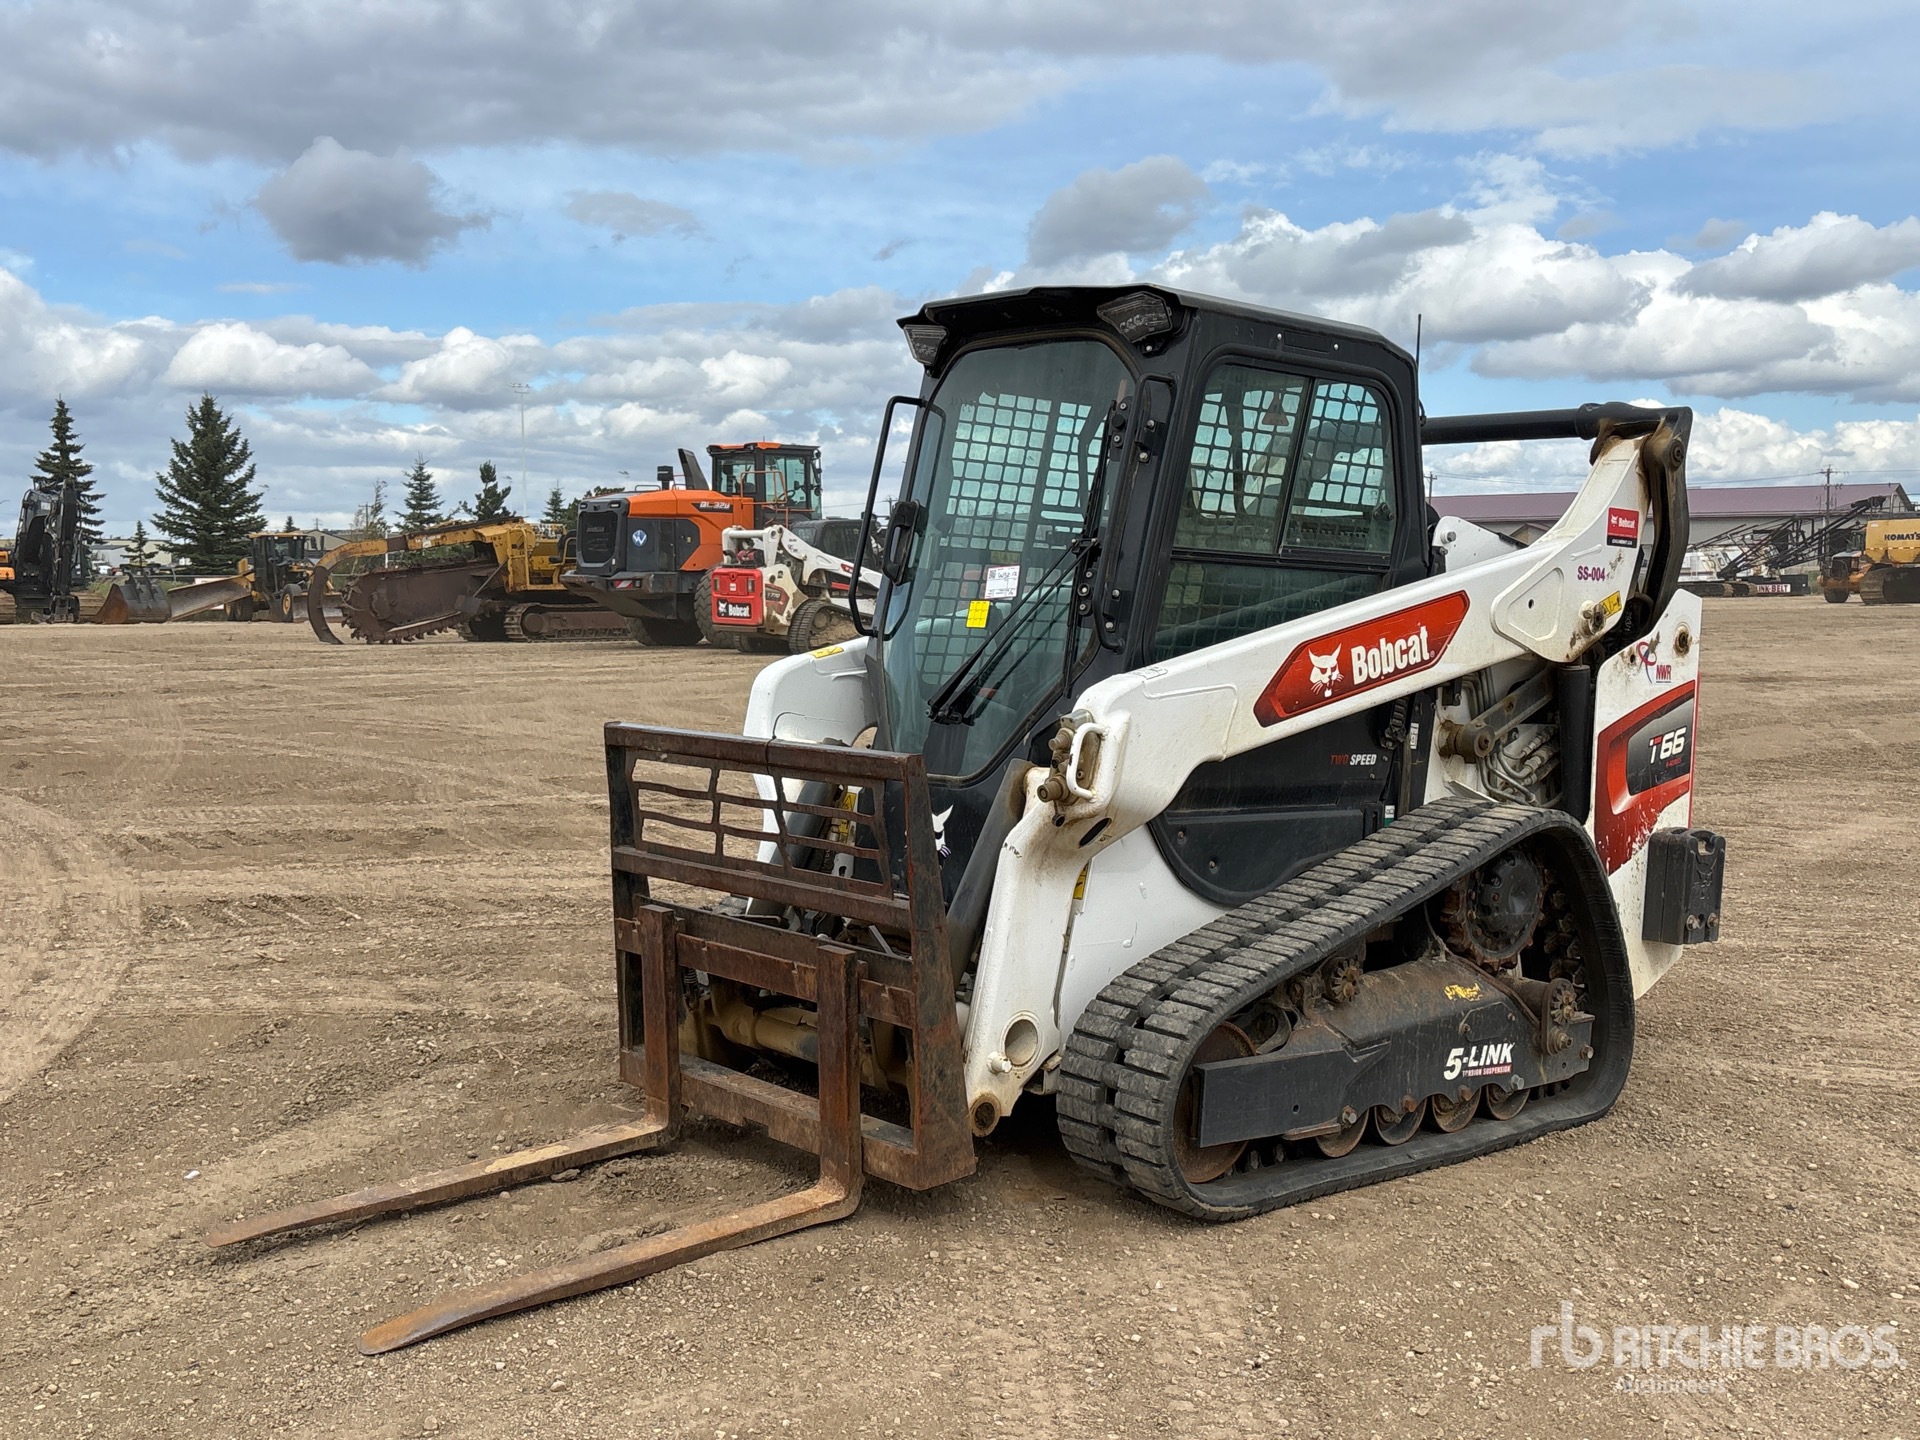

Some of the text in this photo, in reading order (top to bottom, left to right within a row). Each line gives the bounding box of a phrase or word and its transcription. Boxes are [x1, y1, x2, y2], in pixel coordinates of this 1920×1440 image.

[1577, 565, 1606, 581] SS-004
[1758, 584, 1789, 593] INK-BELT
[728, 604, 750, 617] Bobcat
[1351, 625, 1430, 685] Bobcat
[1655, 664, 1672, 680] NWR
[1330, 754, 1377, 766] TWO SPEED
[1443, 1042, 1515, 1080] 5-LINK
